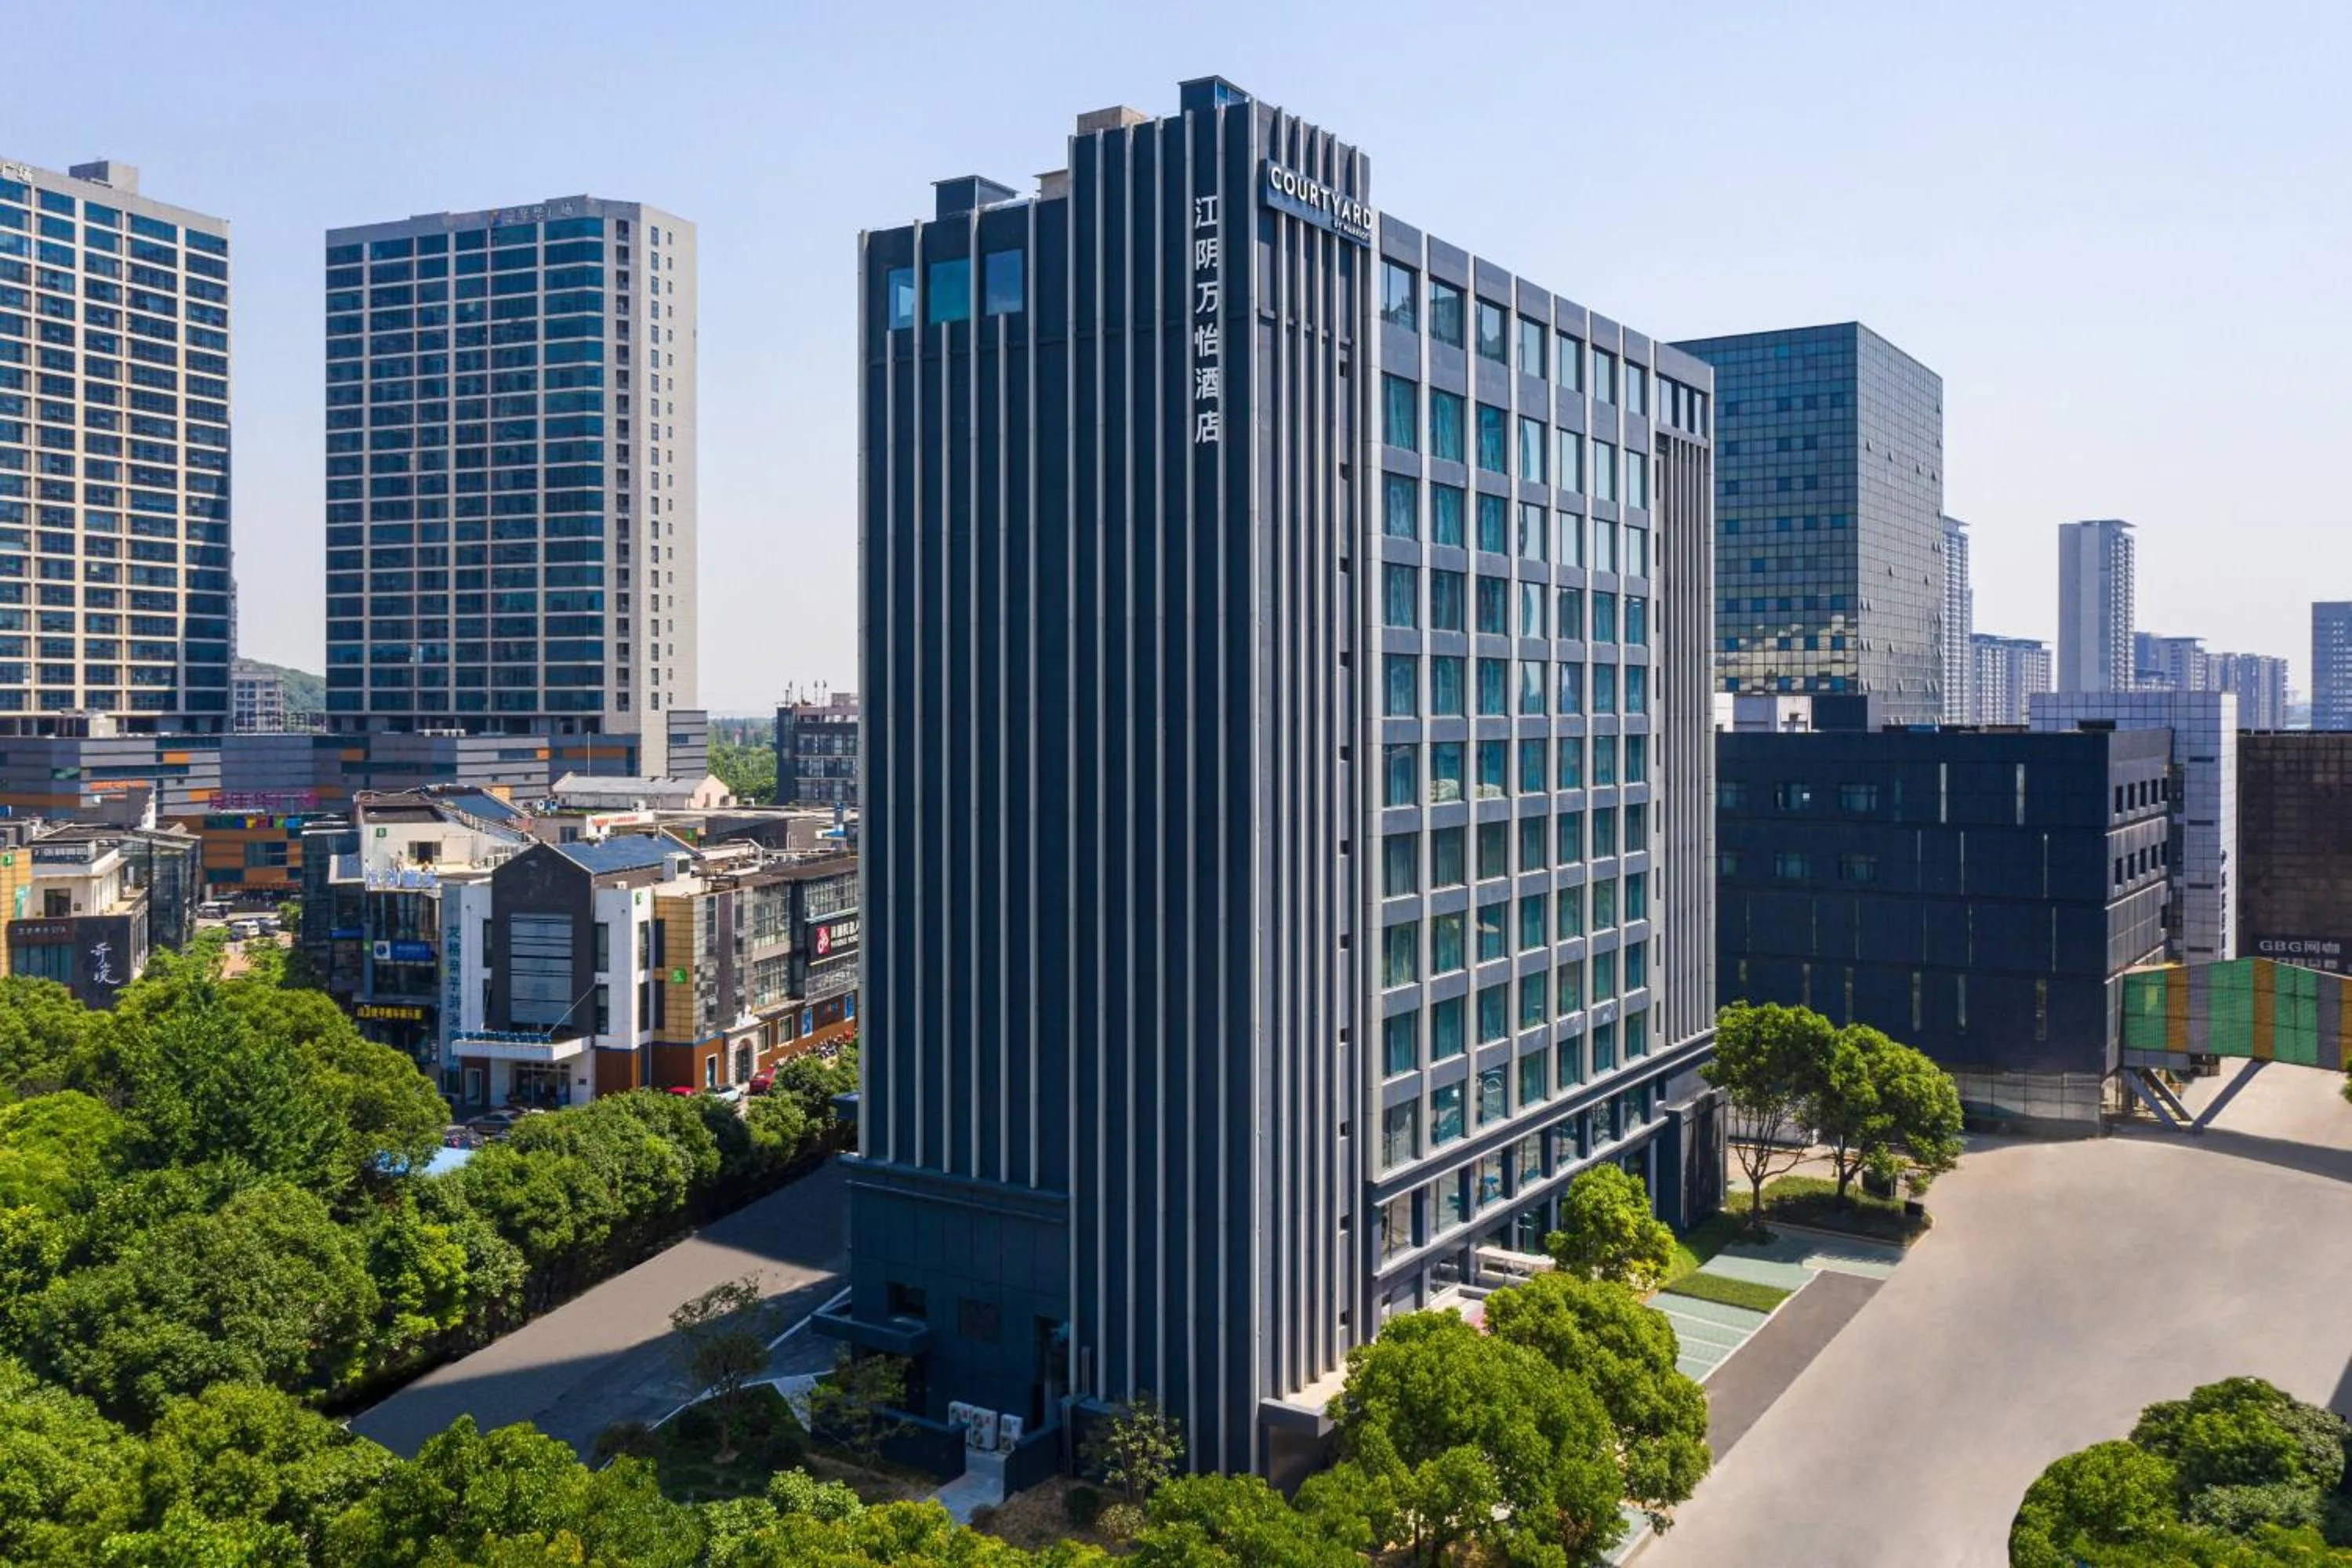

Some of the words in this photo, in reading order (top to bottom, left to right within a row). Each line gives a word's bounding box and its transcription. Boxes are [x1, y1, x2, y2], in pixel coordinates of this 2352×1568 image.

[1271, 166, 1372, 229] COURTYARD
[1194, 194, 1219, 445] 江阴万怡酒店
[2259, 939, 2341, 954] GBG网咖
